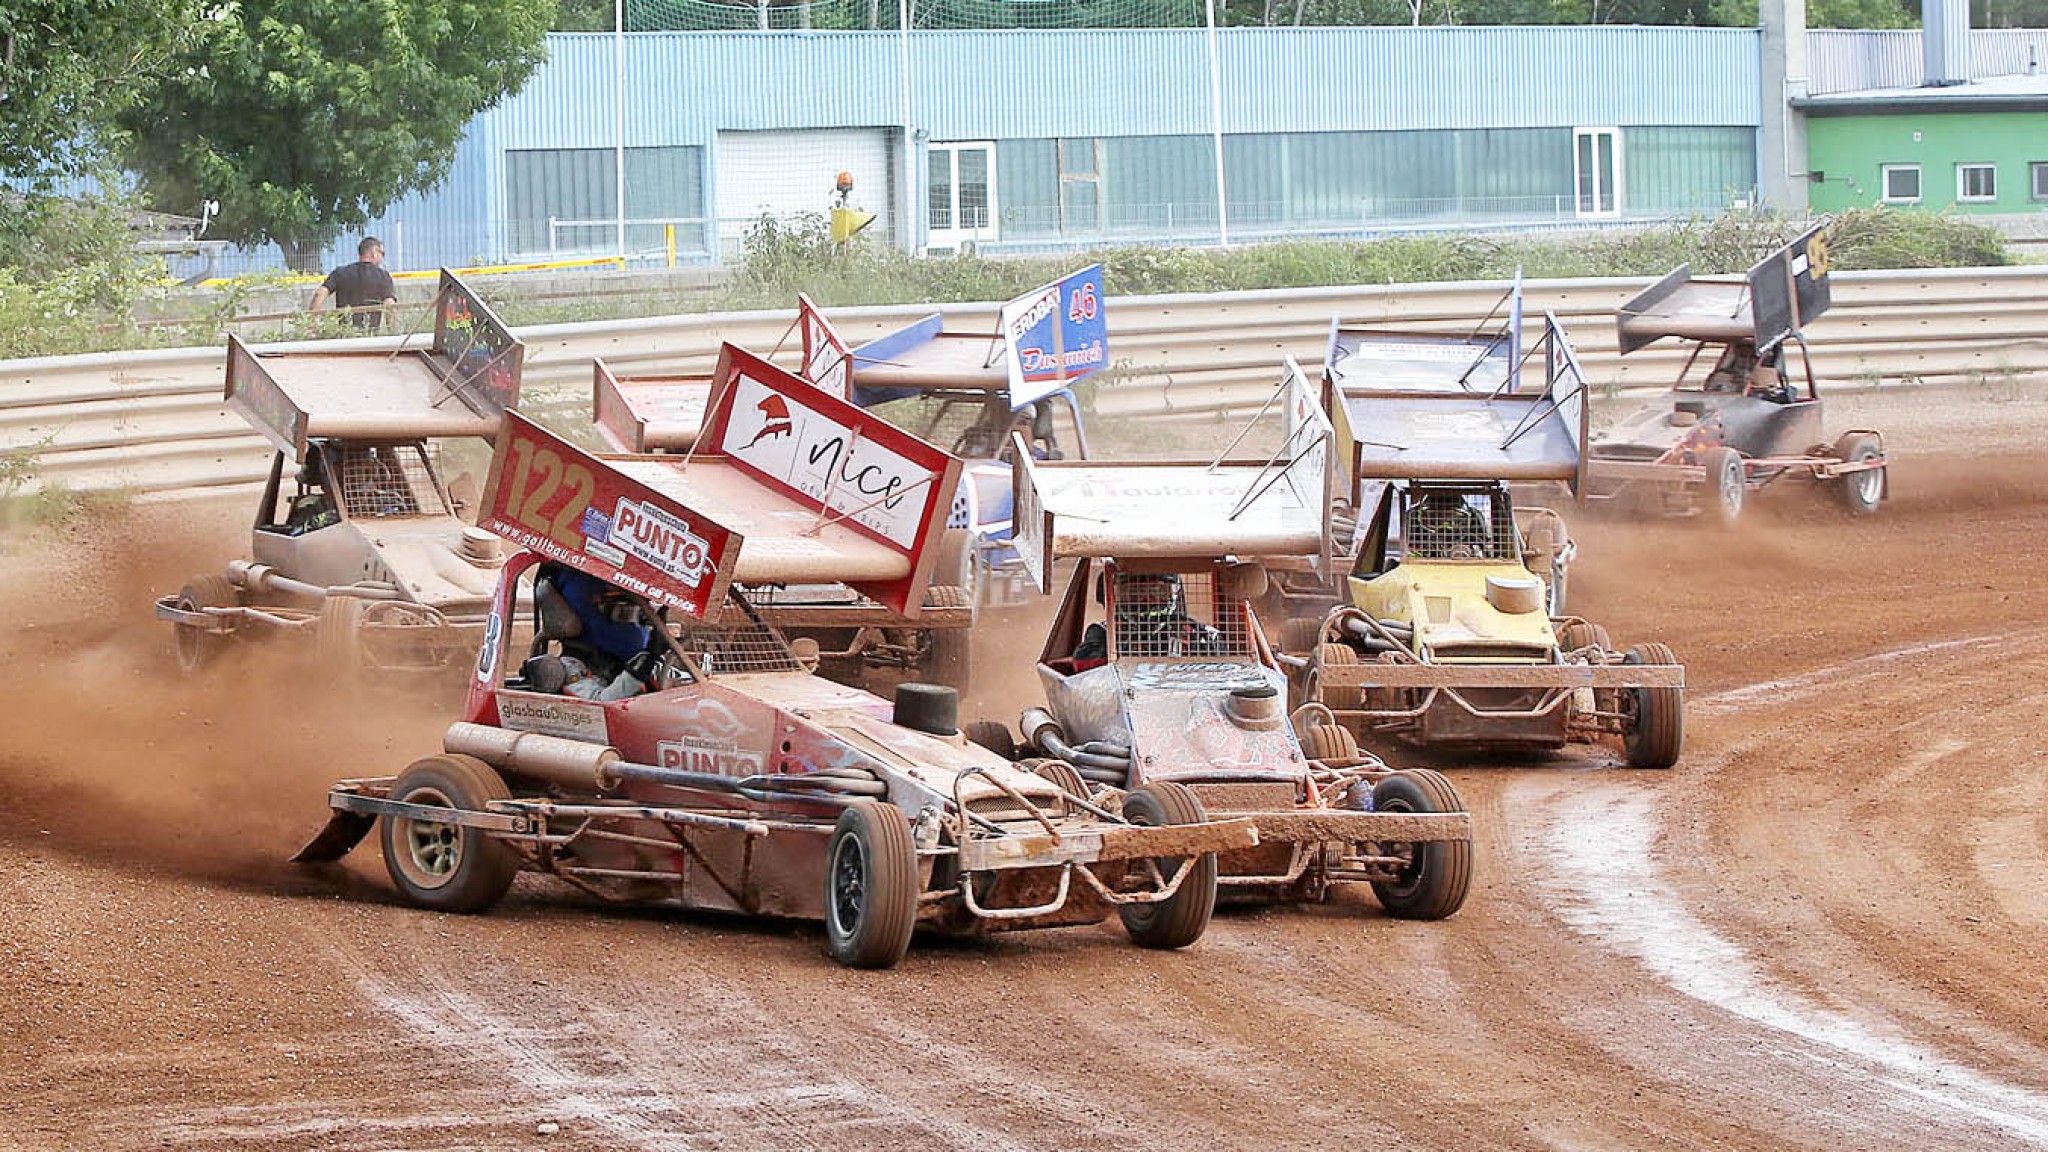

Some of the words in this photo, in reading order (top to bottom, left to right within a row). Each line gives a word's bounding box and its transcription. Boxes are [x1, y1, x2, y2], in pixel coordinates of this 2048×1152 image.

[1068, 282, 1097, 324] 46
[506, 438, 595, 549] 122
[617, 506, 702, 569] PUNTO
